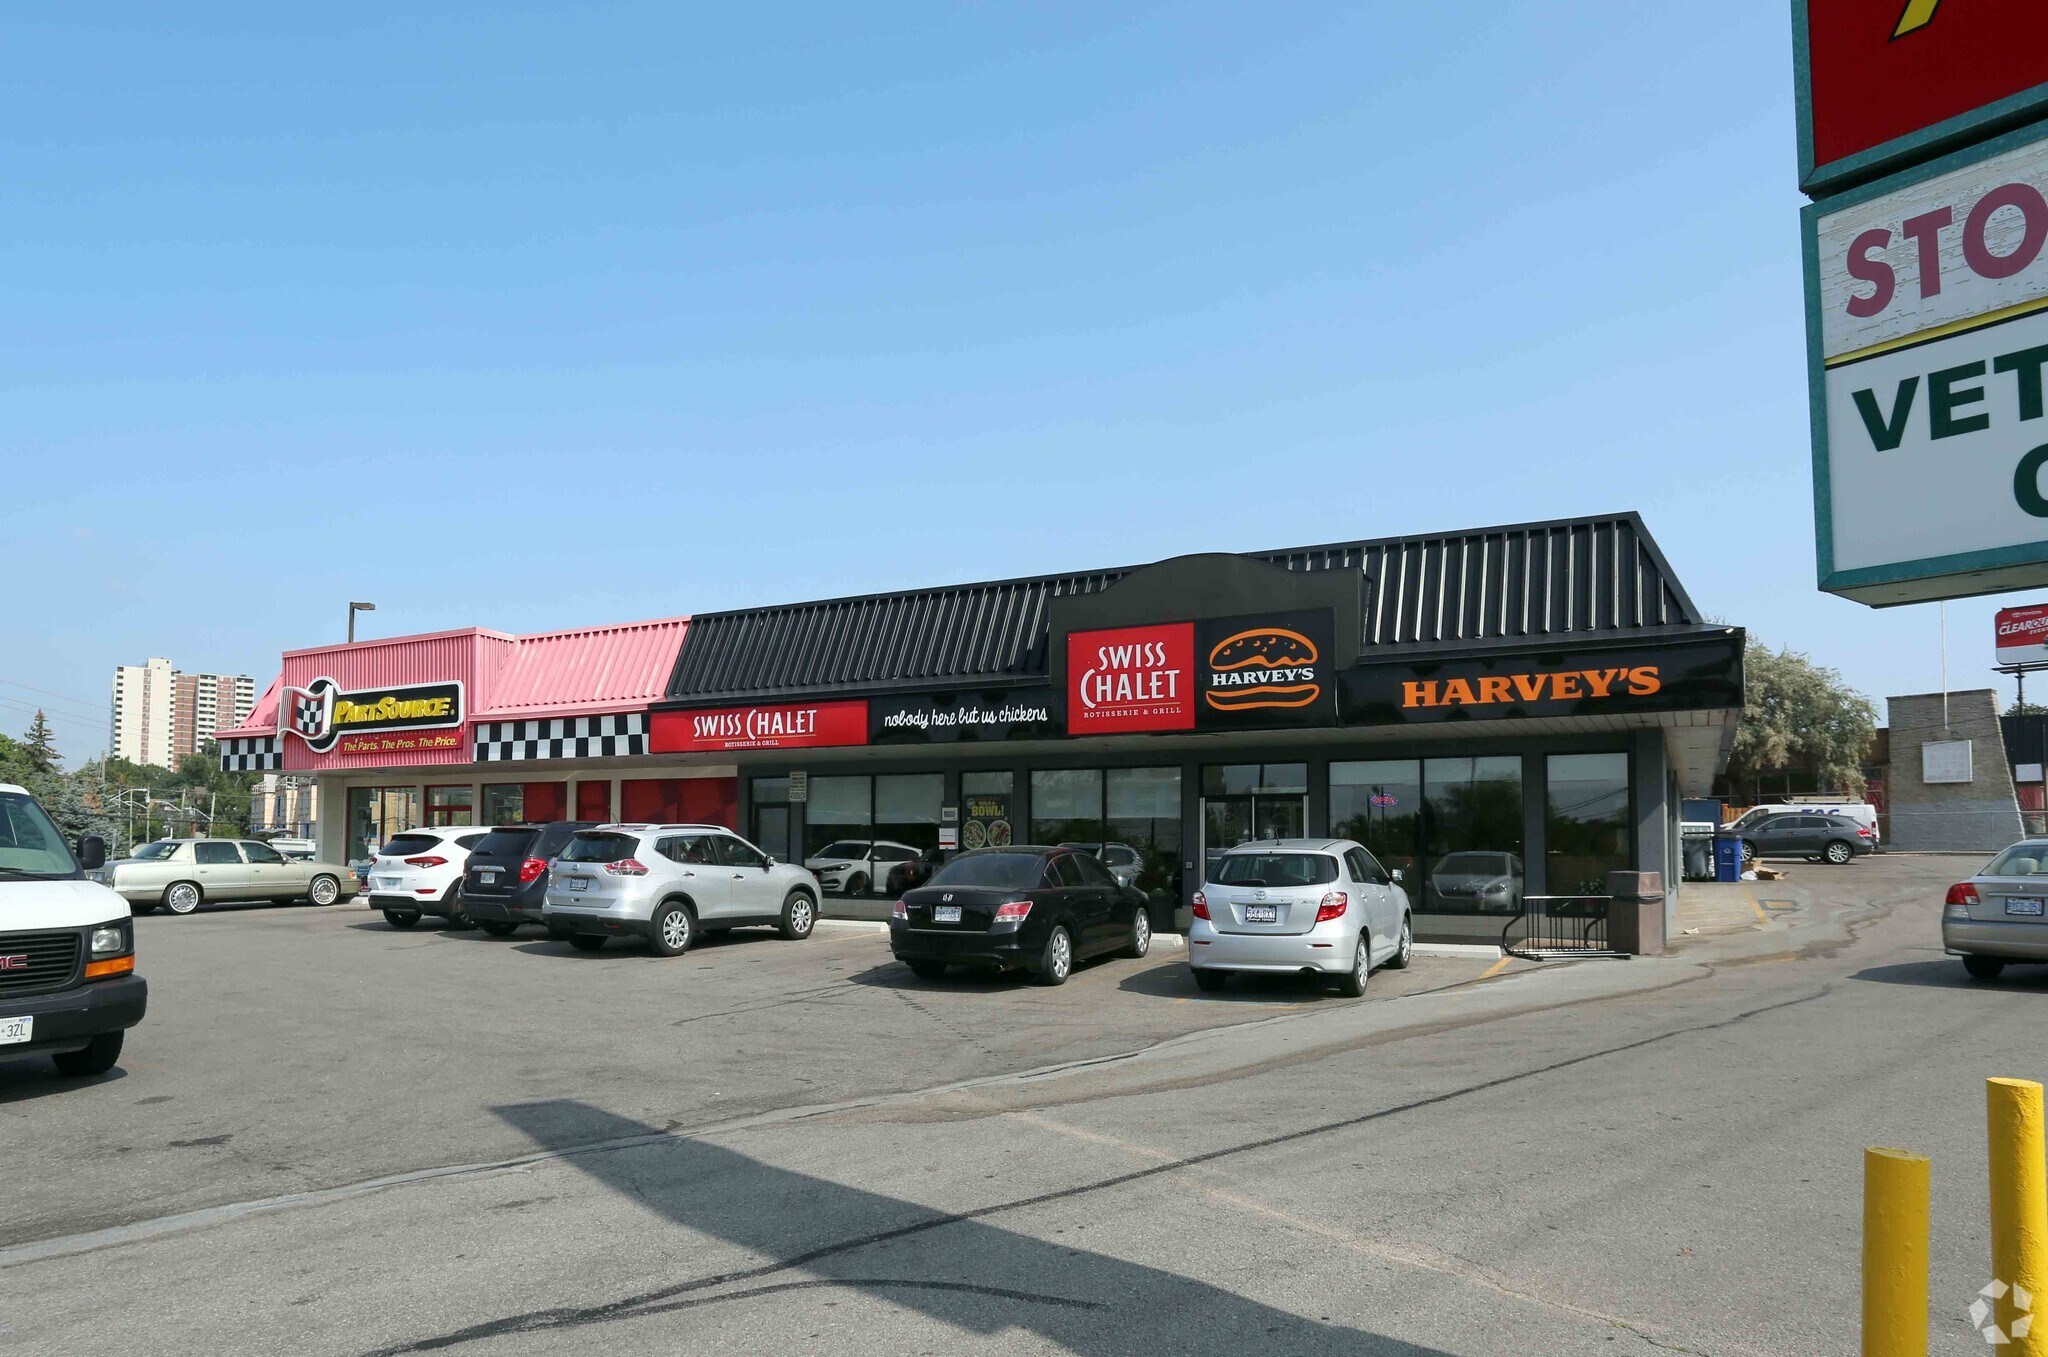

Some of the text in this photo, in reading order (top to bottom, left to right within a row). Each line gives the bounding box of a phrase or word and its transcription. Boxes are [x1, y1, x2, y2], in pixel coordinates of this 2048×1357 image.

[1098, 641, 1166, 671] SWISS
[1080, 668, 1181, 709] CHALET
[1212, 667, 1315, 687] HARVEY'S
[1402, 666, 1661, 707] HARVEY'S
[693, 708, 817, 740] SWISS CHALET
[884, 704, 1048, 729] nobody here but us chickens
[1083, 709, 1139, 719] ROTISSERIE
[1152, 706, 1182, 715] GRILL
[343, 736, 457, 752] The Parts. The Pros. The Price.
[724, 740, 756, 748] ROTISSERIE
